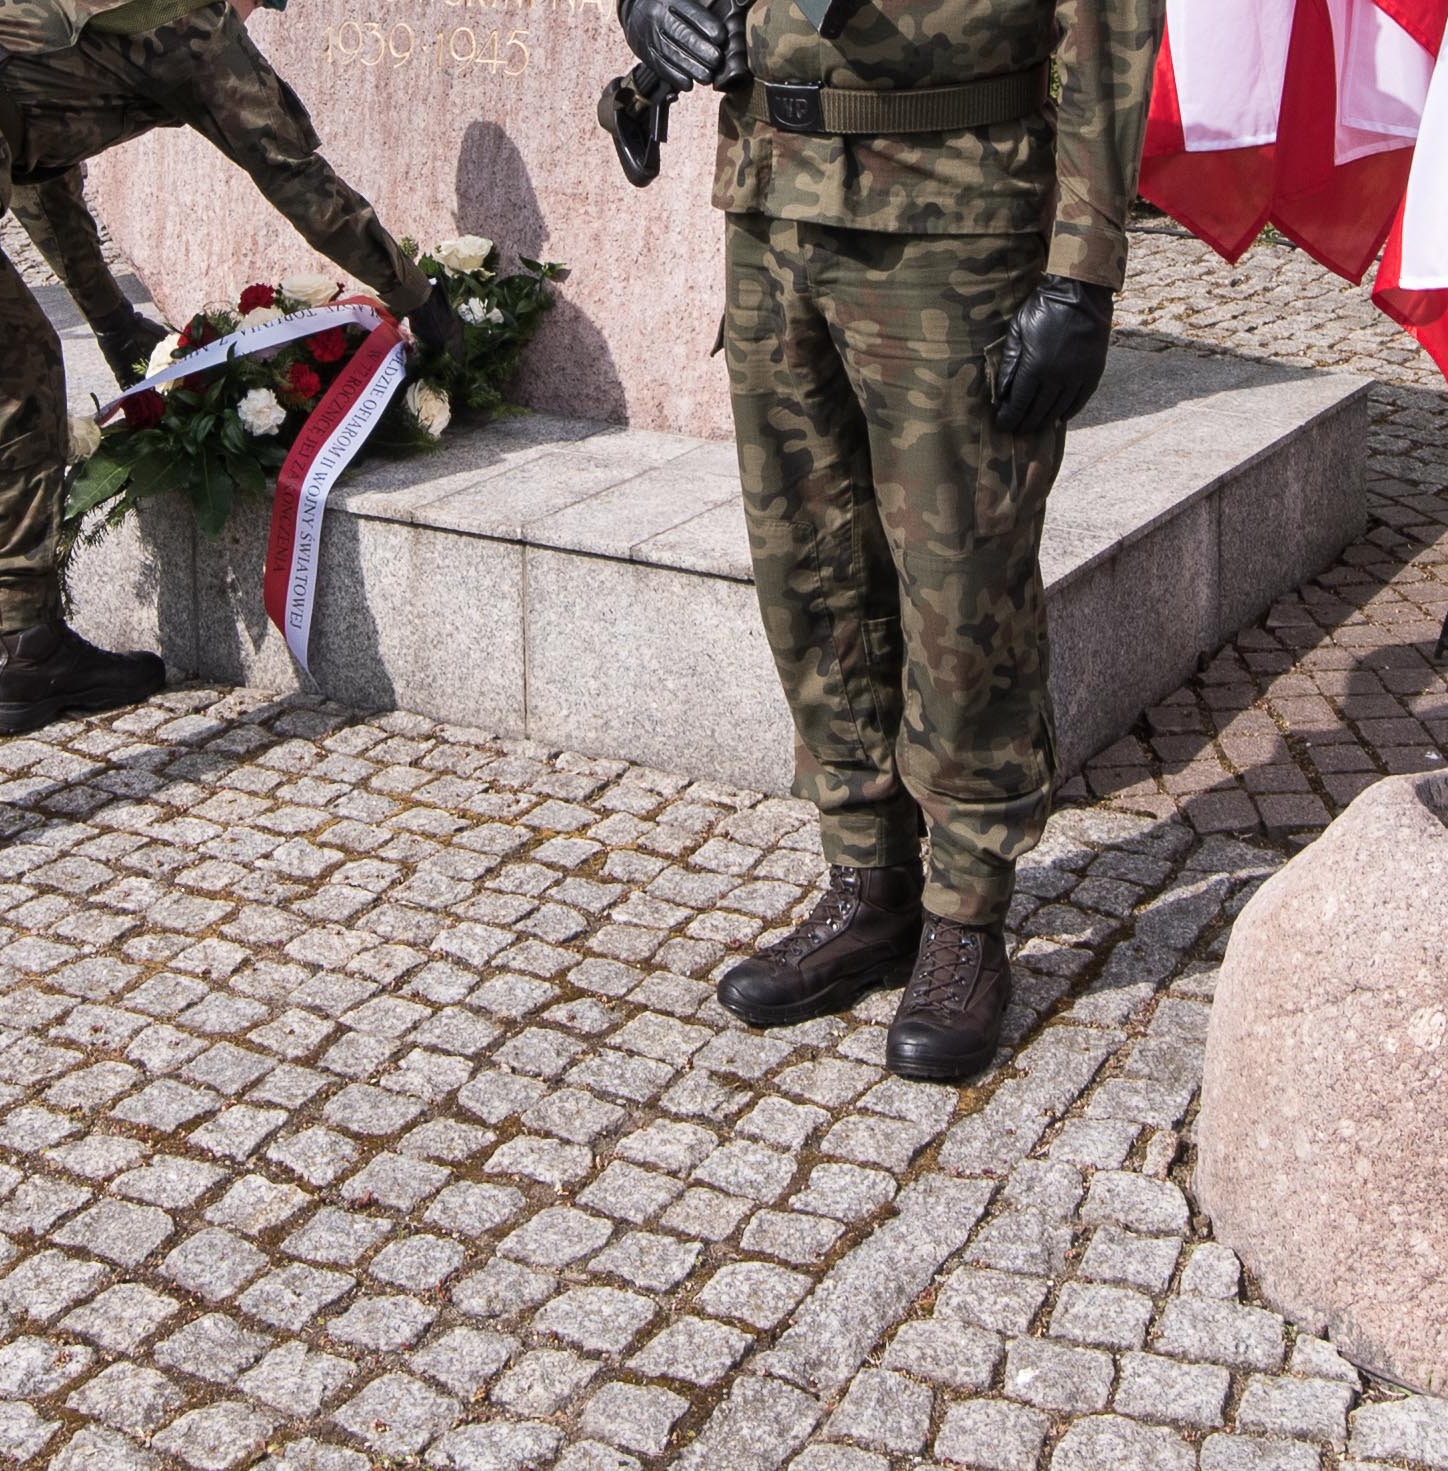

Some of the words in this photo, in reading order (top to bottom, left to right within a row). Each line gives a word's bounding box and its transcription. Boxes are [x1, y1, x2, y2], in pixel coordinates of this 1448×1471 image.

[328, 399, 378, 458] OFIAROM
[301, 471, 329, 526] WOJNY
[290, 532, 316, 630] ŚWIATOWEJ
